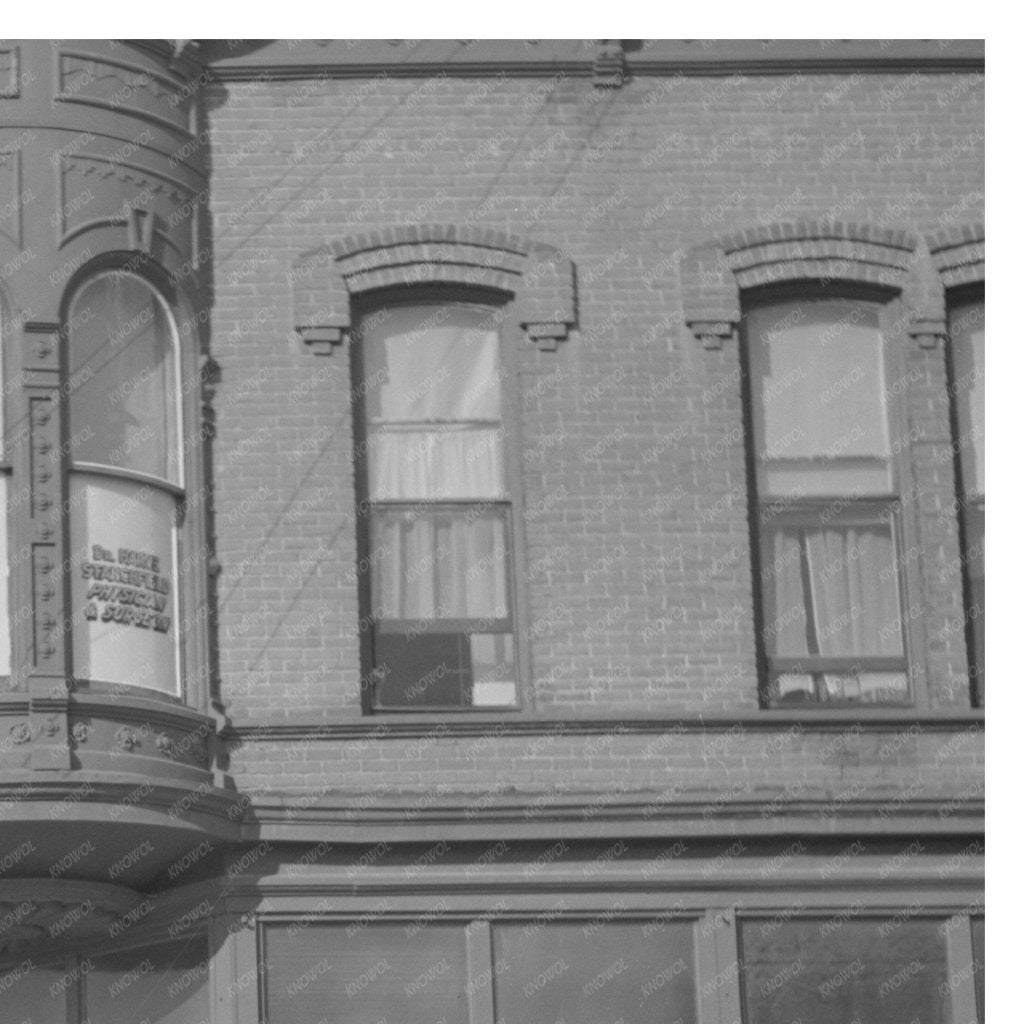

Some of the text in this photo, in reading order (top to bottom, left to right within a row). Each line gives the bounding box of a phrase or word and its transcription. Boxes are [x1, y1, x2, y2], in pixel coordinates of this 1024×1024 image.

[81, 561, 171, 596] STANCHFIELD
[86, 583, 167, 614] PHYSICIAN
[101, 604, 171, 634] SURGEON
